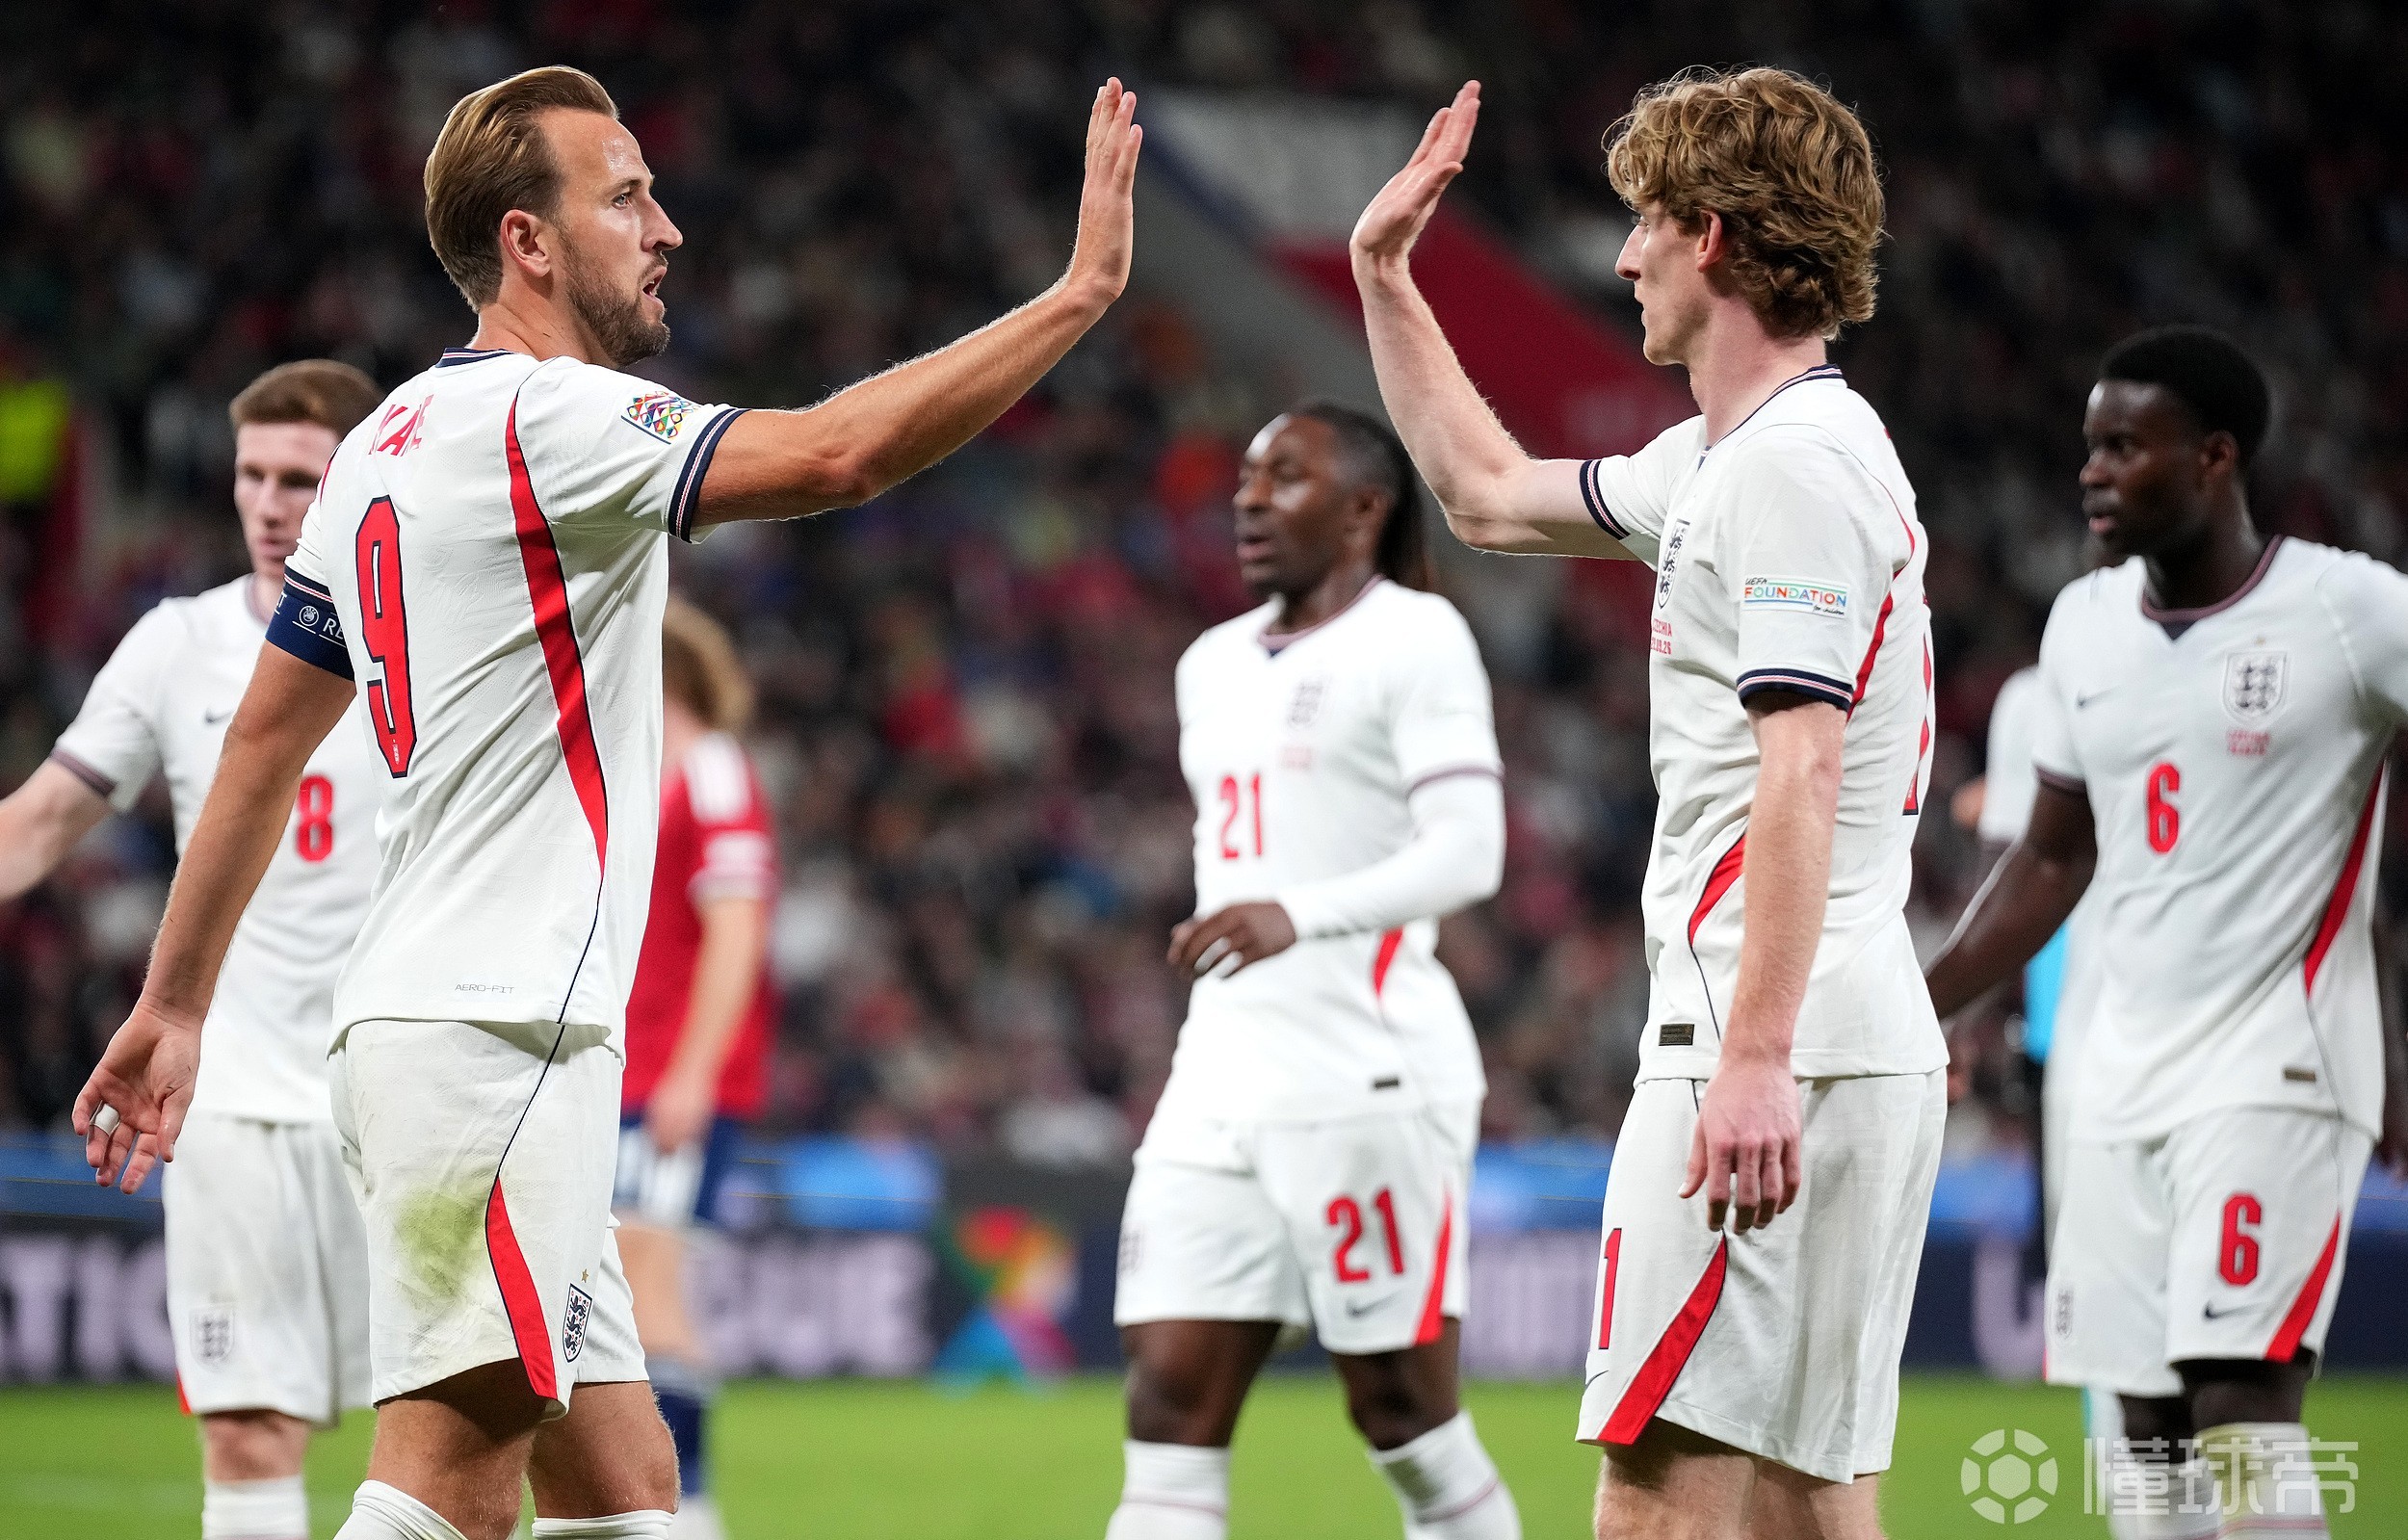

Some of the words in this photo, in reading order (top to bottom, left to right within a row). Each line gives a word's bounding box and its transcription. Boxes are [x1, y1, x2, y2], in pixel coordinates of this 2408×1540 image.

[1743, 586, 1847, 607] FOUNDATION
[1744, 577, 1767, 586] UEFA
[355, 494, 417, 778] 9
[297, 775, 332, 862] 8
[1218, 773, 1263, 859] 21
[2146, 762, 2181, 854] 6
[455, 983, 514, 994] AERO-FIT
[1326, 1186, 1404, 1283] 21
[2219, 1191, 2262, 1287] 6
